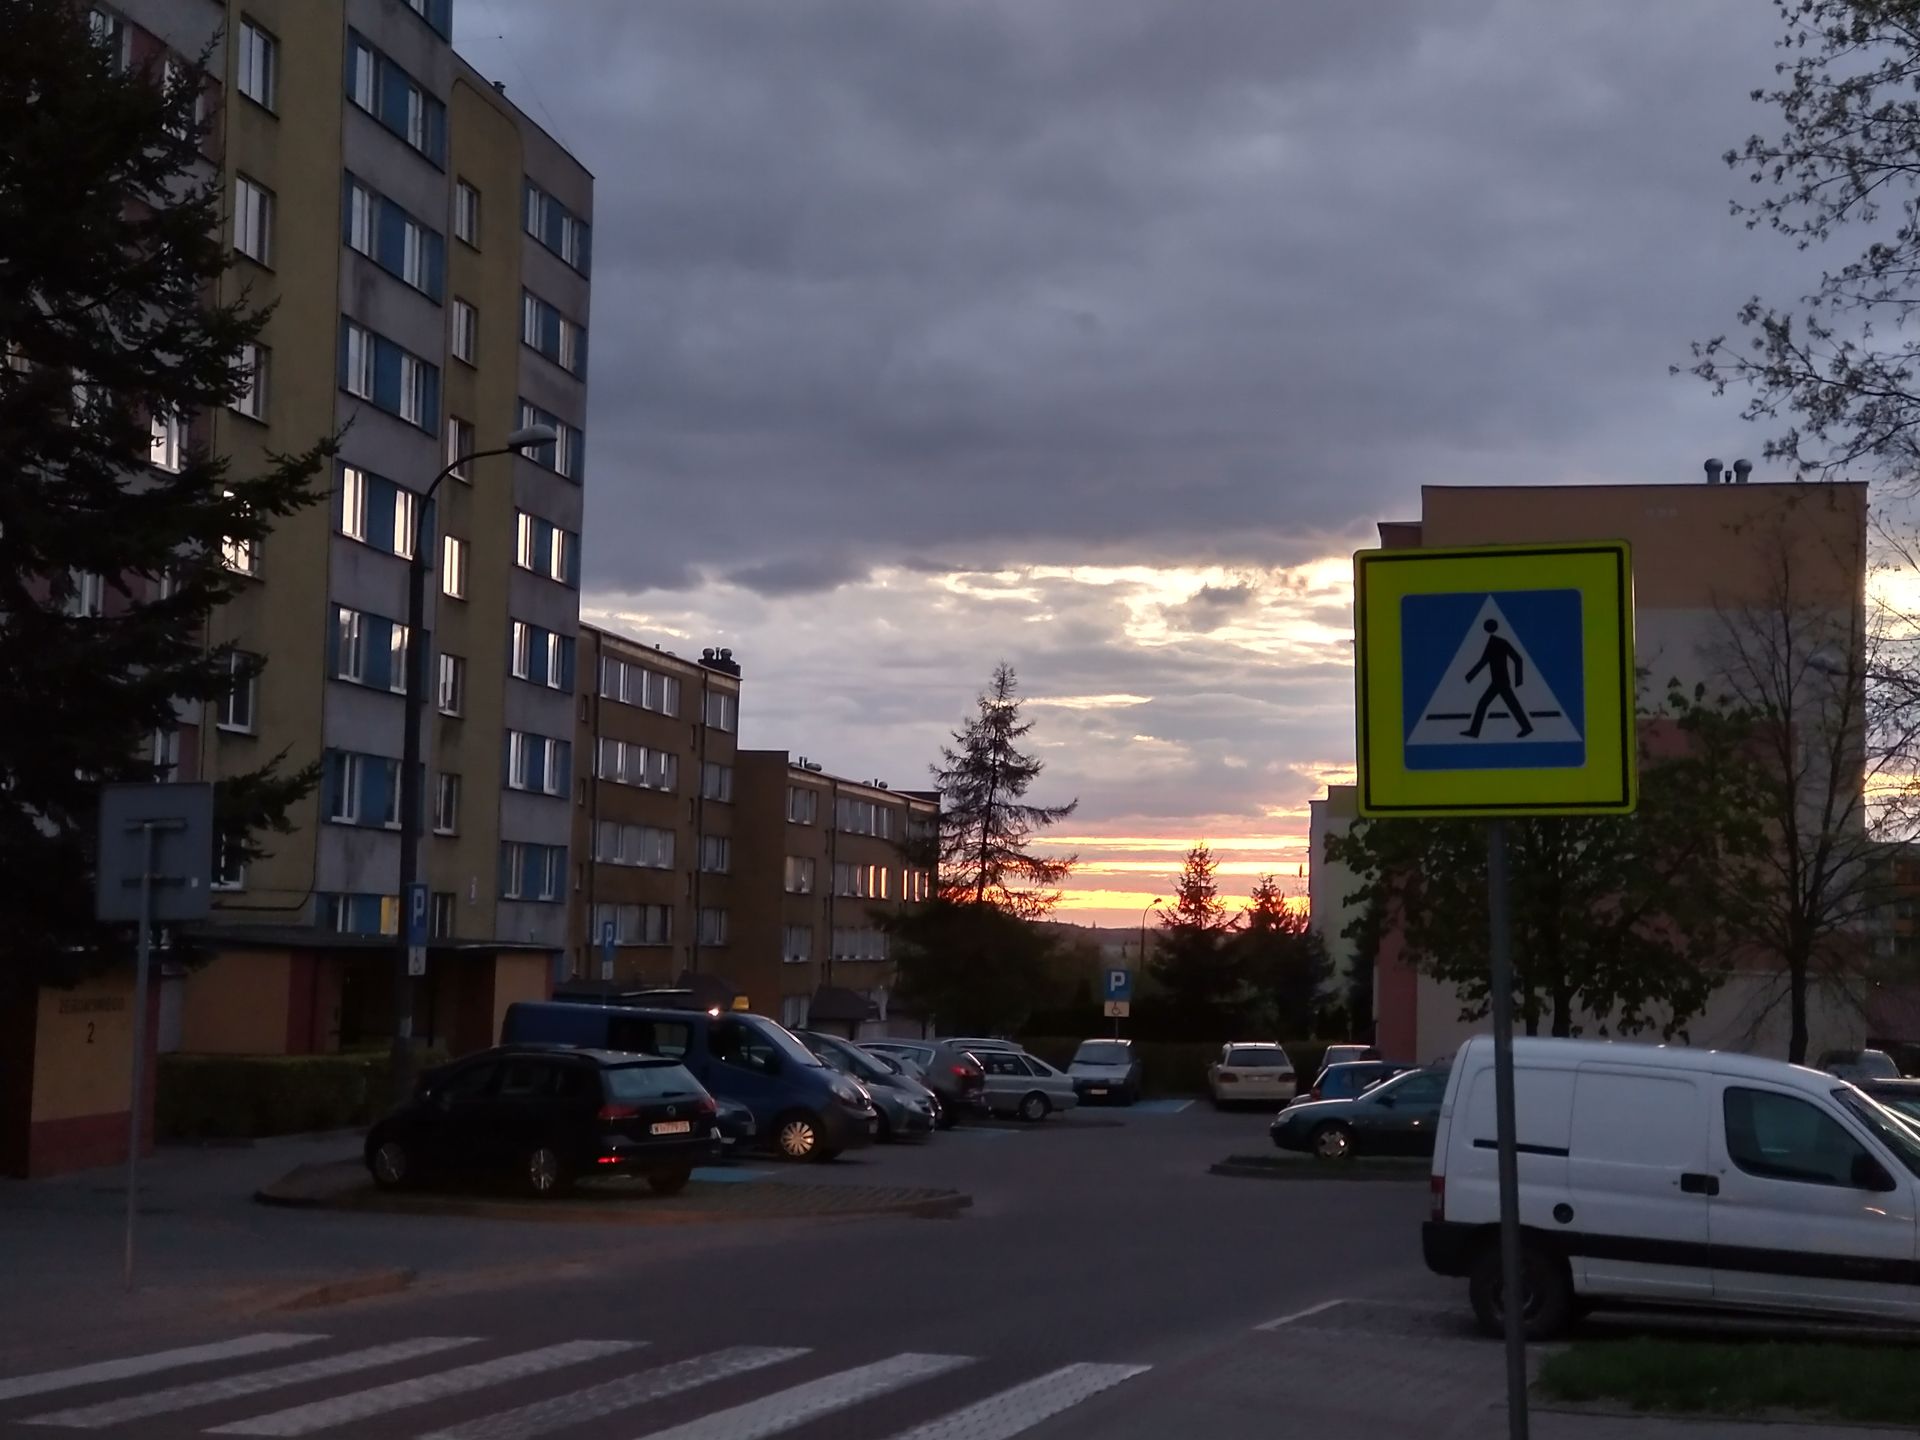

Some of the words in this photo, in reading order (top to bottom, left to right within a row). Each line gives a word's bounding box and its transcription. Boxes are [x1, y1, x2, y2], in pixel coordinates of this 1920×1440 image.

[413, 888, 425, 927] P
[606, 924, 614, 947] P
[1111, 972, 1126, 991] P
[87, 1022, 95, 1043] 2
